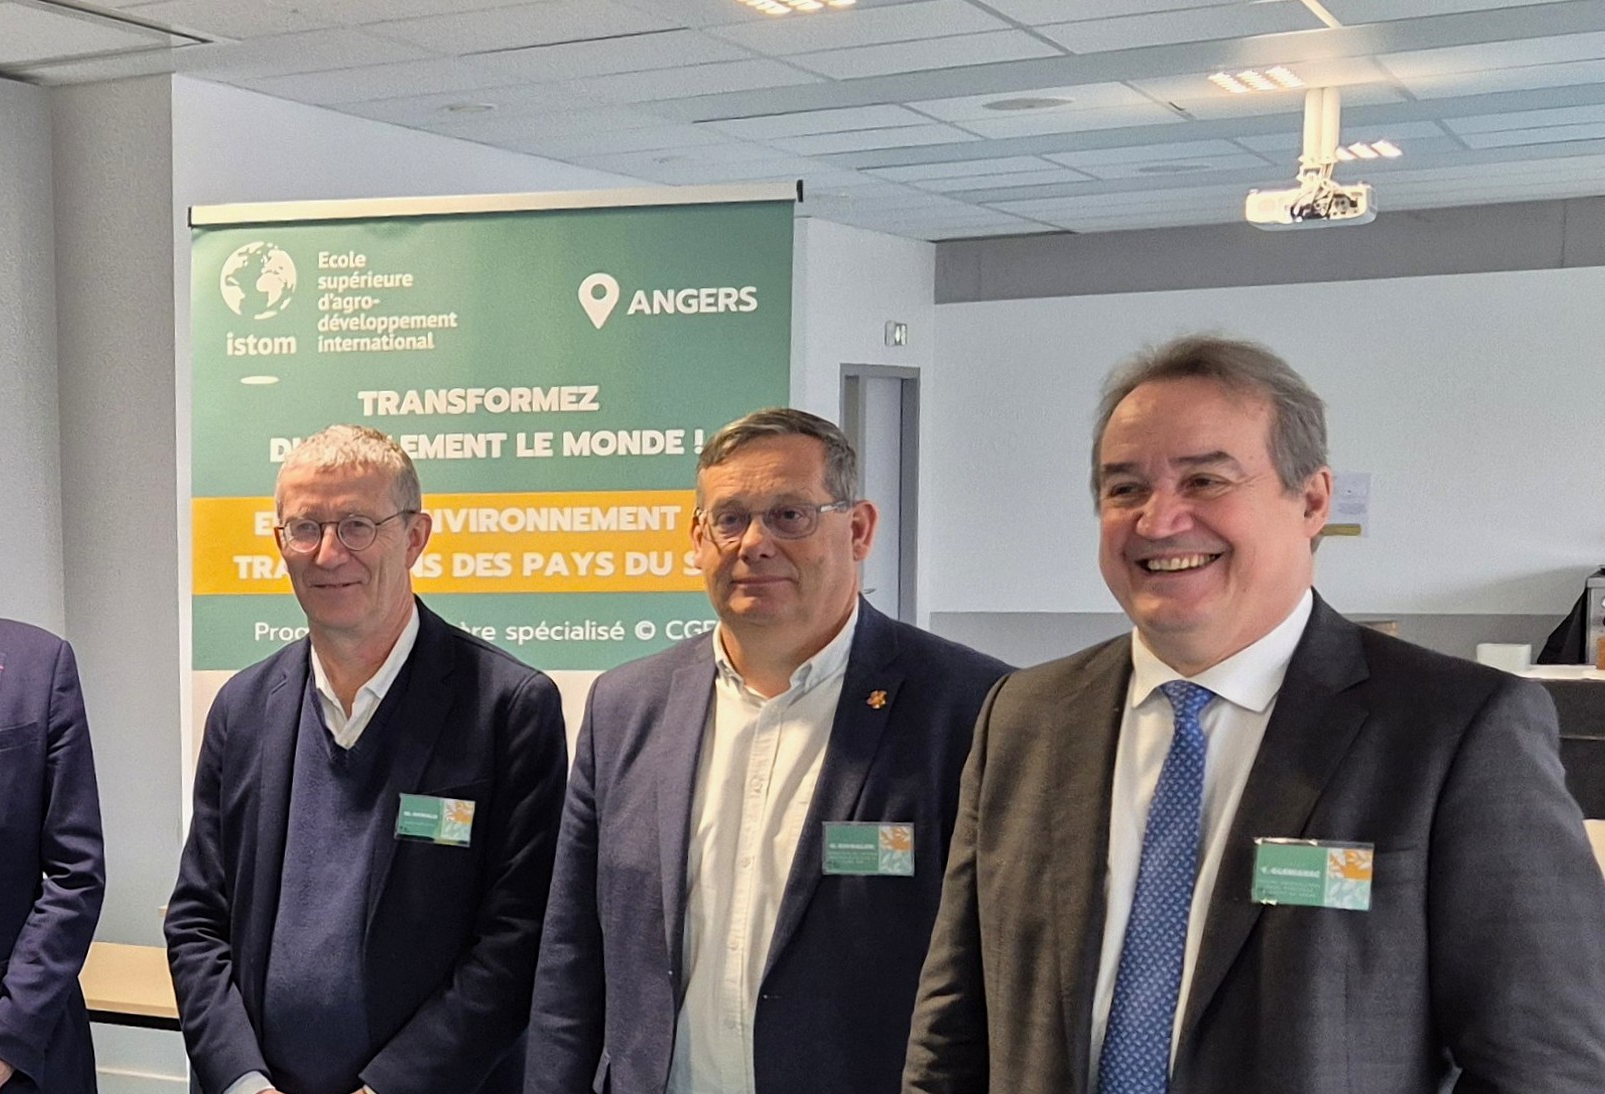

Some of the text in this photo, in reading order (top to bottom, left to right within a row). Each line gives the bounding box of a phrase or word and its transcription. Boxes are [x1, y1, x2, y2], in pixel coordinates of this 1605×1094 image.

[318, 251, 366, 269] Ecole
[318, 272, 414, 293] supérieure
[318, 294, 381, 314] d'agro-
[627, 286, 758, 315] ANGERS
[318, 311, 458, 334] développement
[226, 332, 297, 356] istom
[318, 332, 435, 353] international
[357, 386, 600, 417] TRANSFORMEZ
[516, 431, 554, 457] LE
[563, 430, 686, 456] MONDE
[452, 552, 513, 577] DES
[522, 551, 614, 577] PAYS
[625, 551, 674, 576] DU
[505, 619, 625, 645] spécialisé
